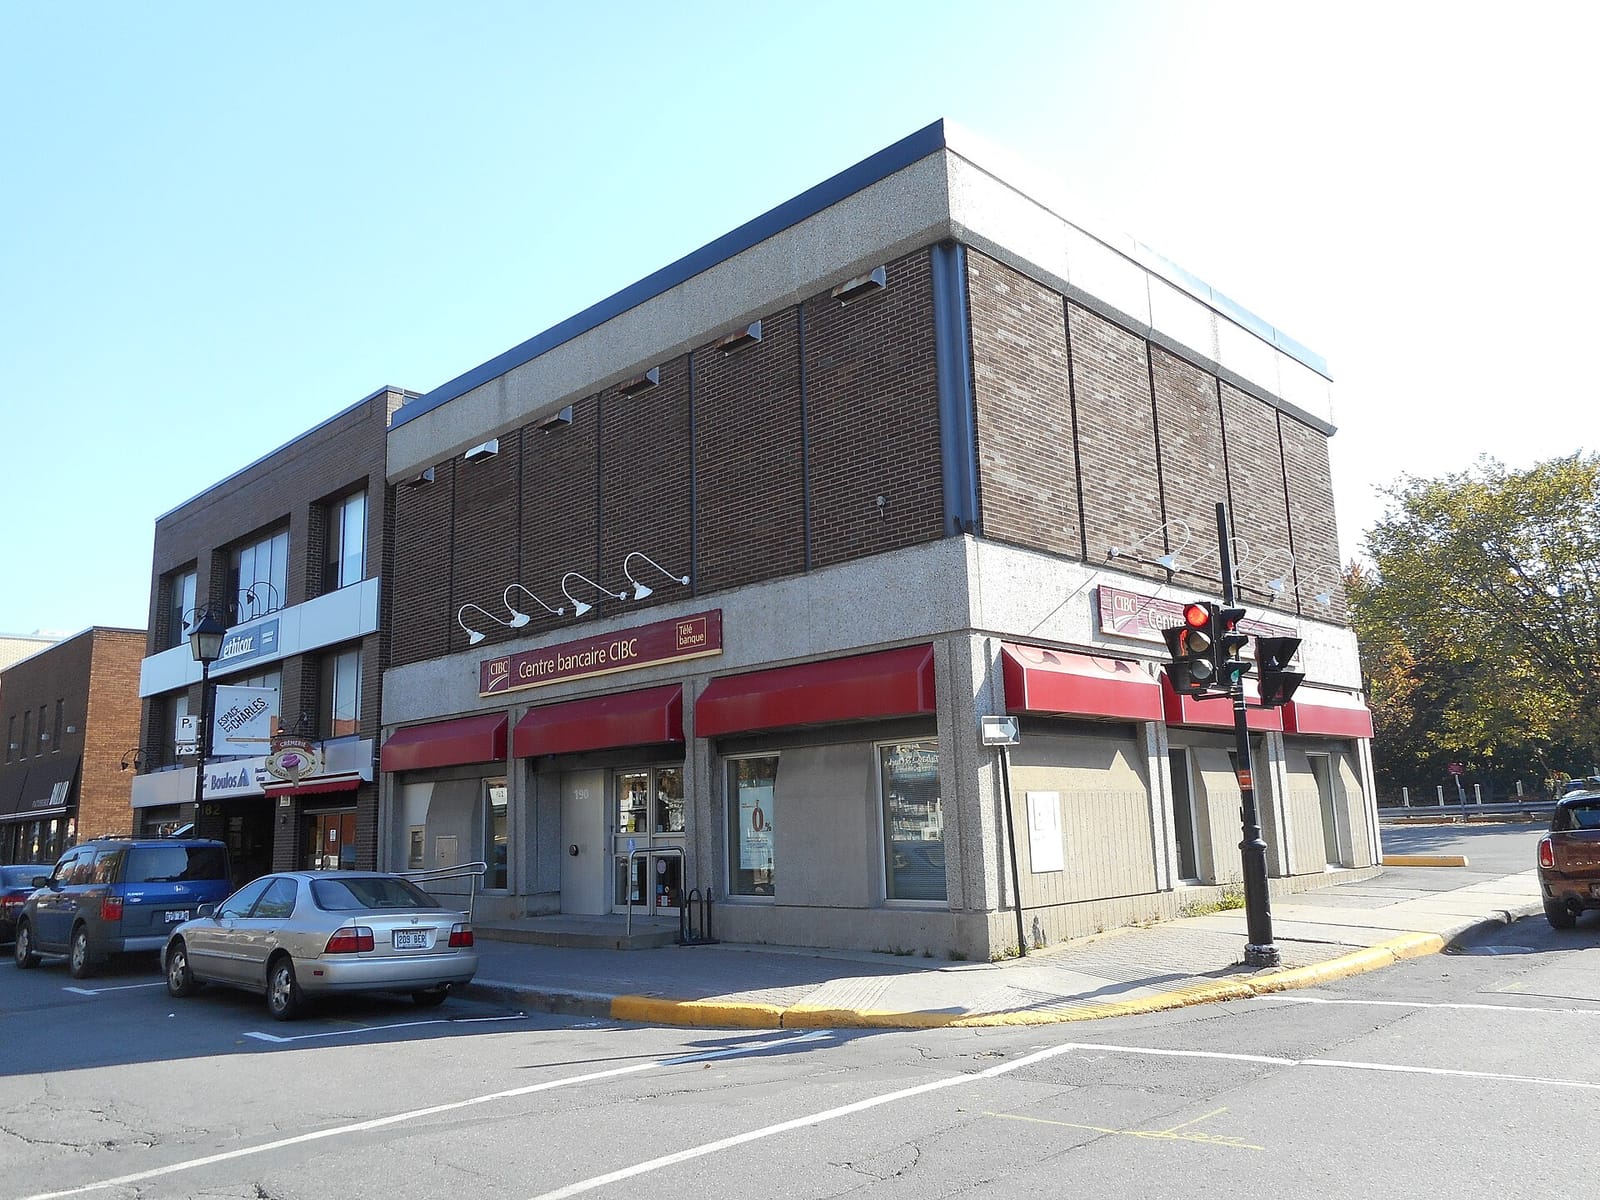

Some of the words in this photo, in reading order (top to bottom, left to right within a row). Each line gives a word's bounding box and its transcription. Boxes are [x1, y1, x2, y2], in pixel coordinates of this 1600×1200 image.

[1114, 595, 1136, 612] CIBC
[679, 623, 693, 635] Télé
[679, 633, 705, 645] banque
[490, 659, 508, 676] CIBC
[519, 659, 555, 680] Centre
[556, 646, 607, 672] bancaire
[609, 638, 638, 660] CIBC
[217, 705, 241, 727] ESPACE
[211, 772, 237, 790] Boulos
